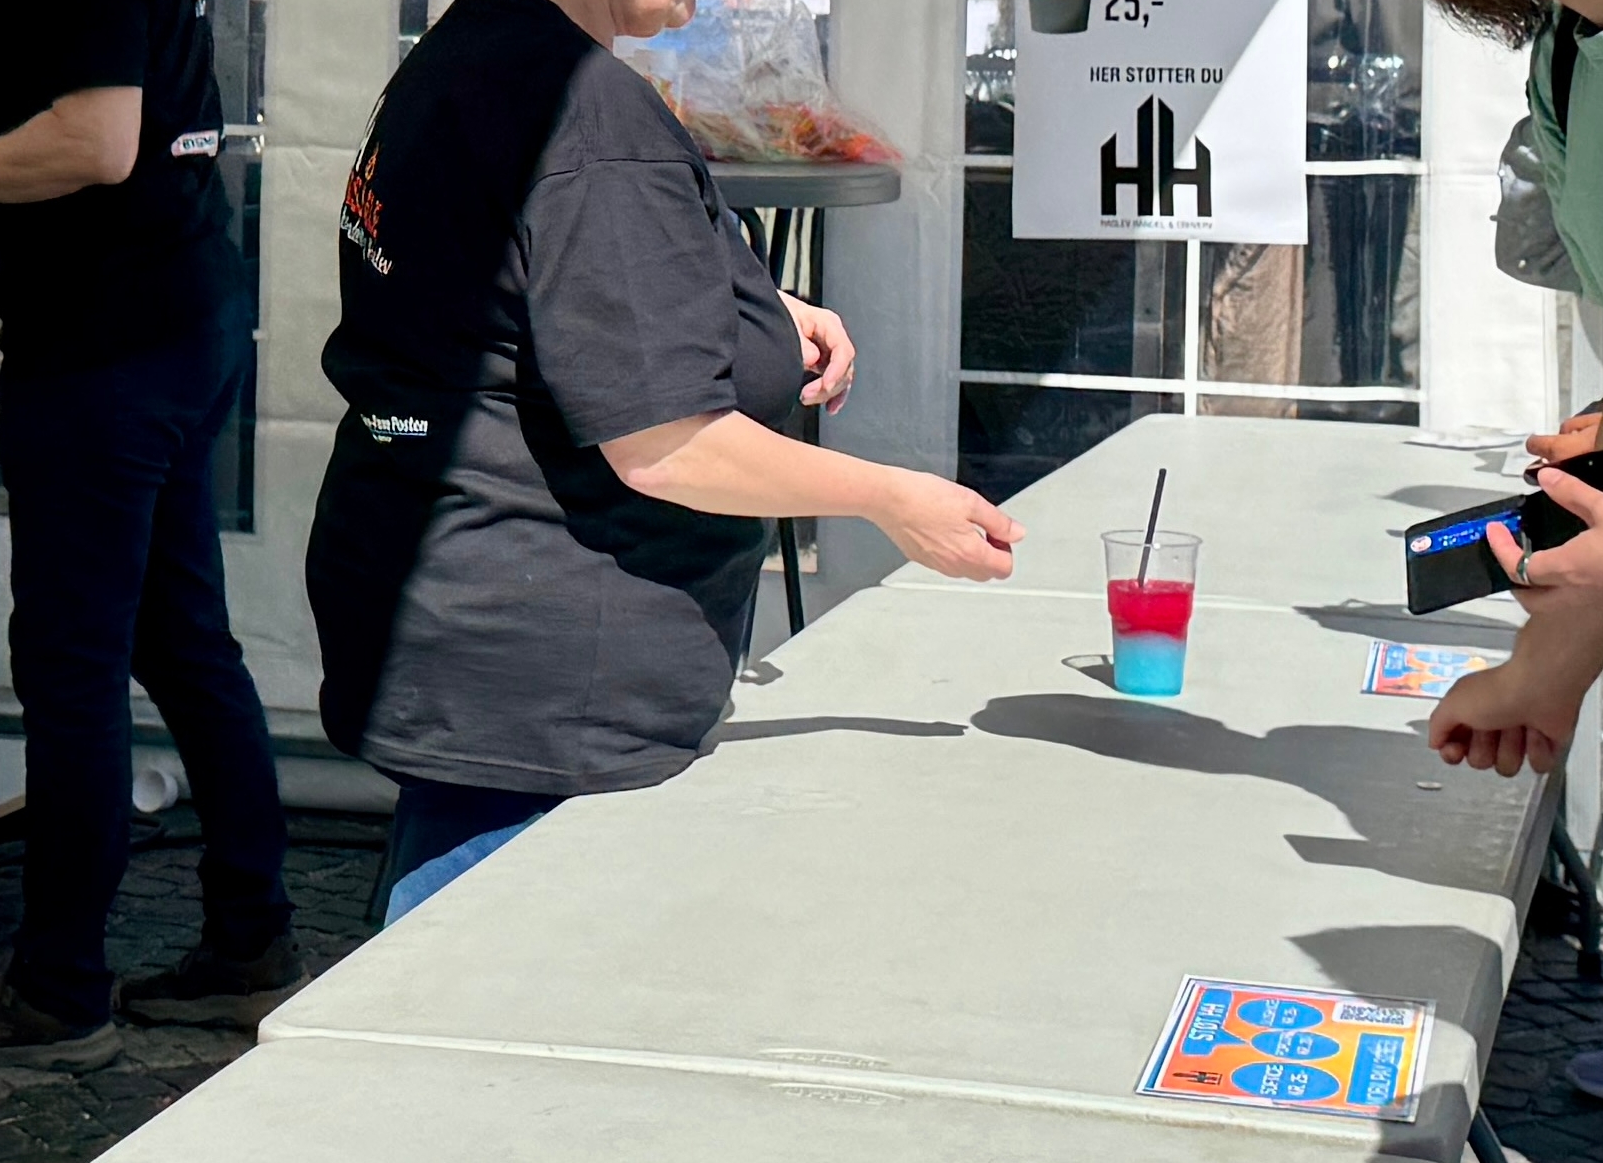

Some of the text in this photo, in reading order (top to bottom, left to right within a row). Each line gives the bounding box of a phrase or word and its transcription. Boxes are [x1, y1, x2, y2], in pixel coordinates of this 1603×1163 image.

[1090, 67, 1224, 84] HER STØTTER DU
